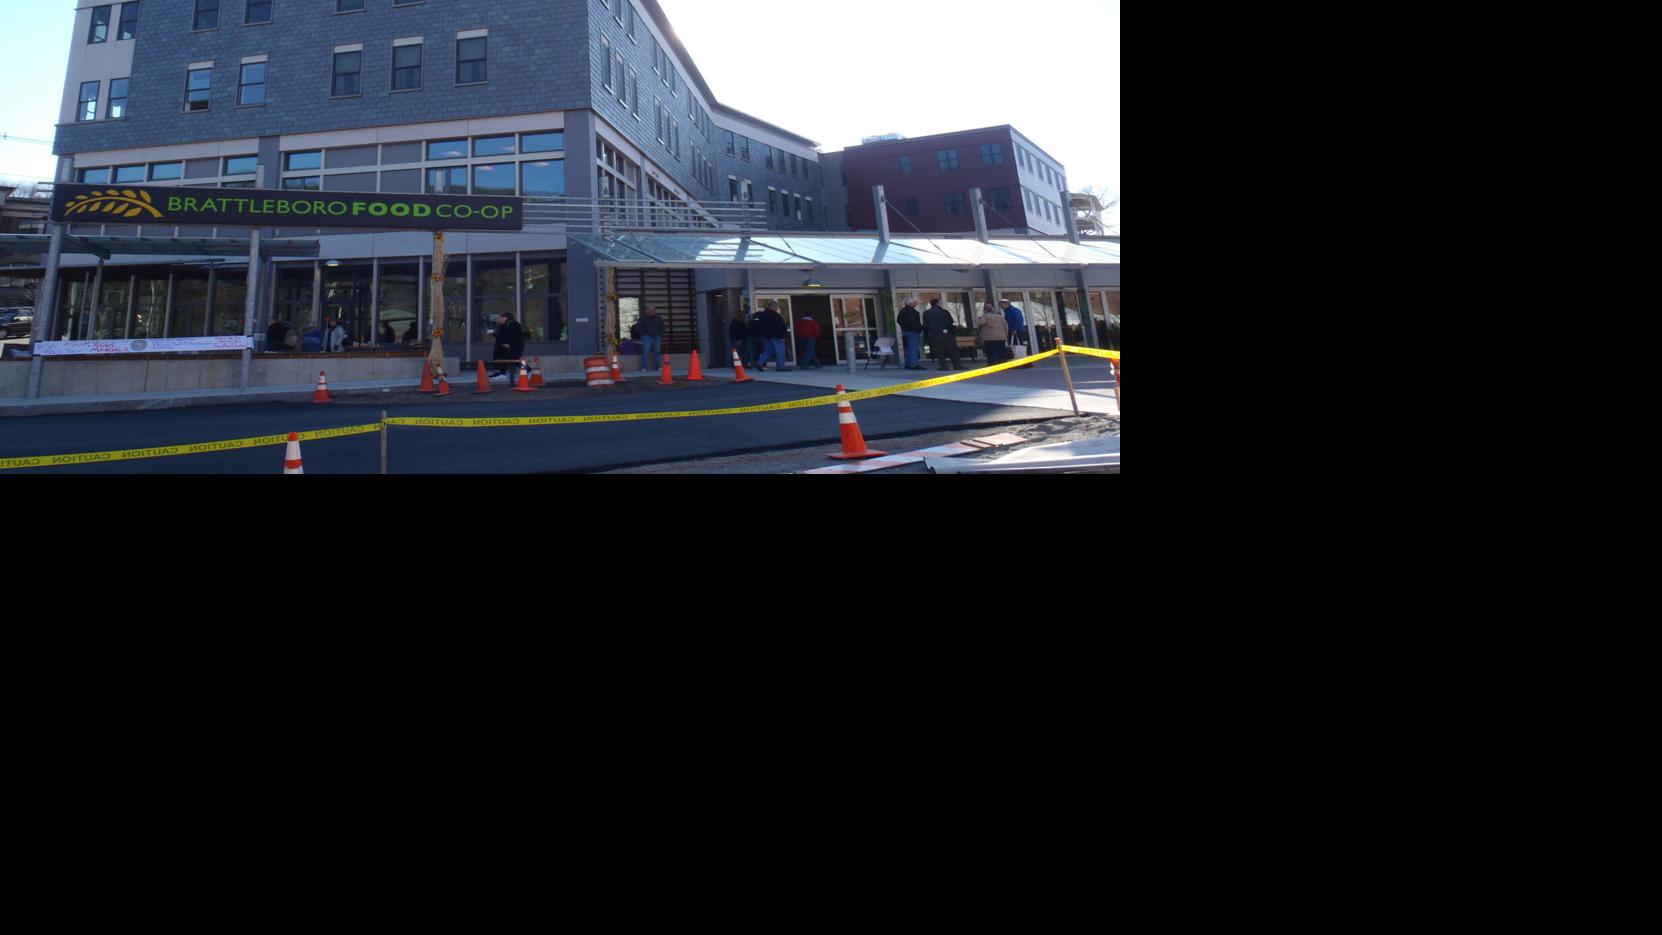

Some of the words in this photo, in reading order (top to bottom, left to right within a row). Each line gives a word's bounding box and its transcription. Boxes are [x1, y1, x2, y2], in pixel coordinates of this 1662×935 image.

[167, 196, 347, 215] BRATTLEBORO
[351, 201, 431, 217] FOOD
[435, 204, 513, 219] CO-OP
